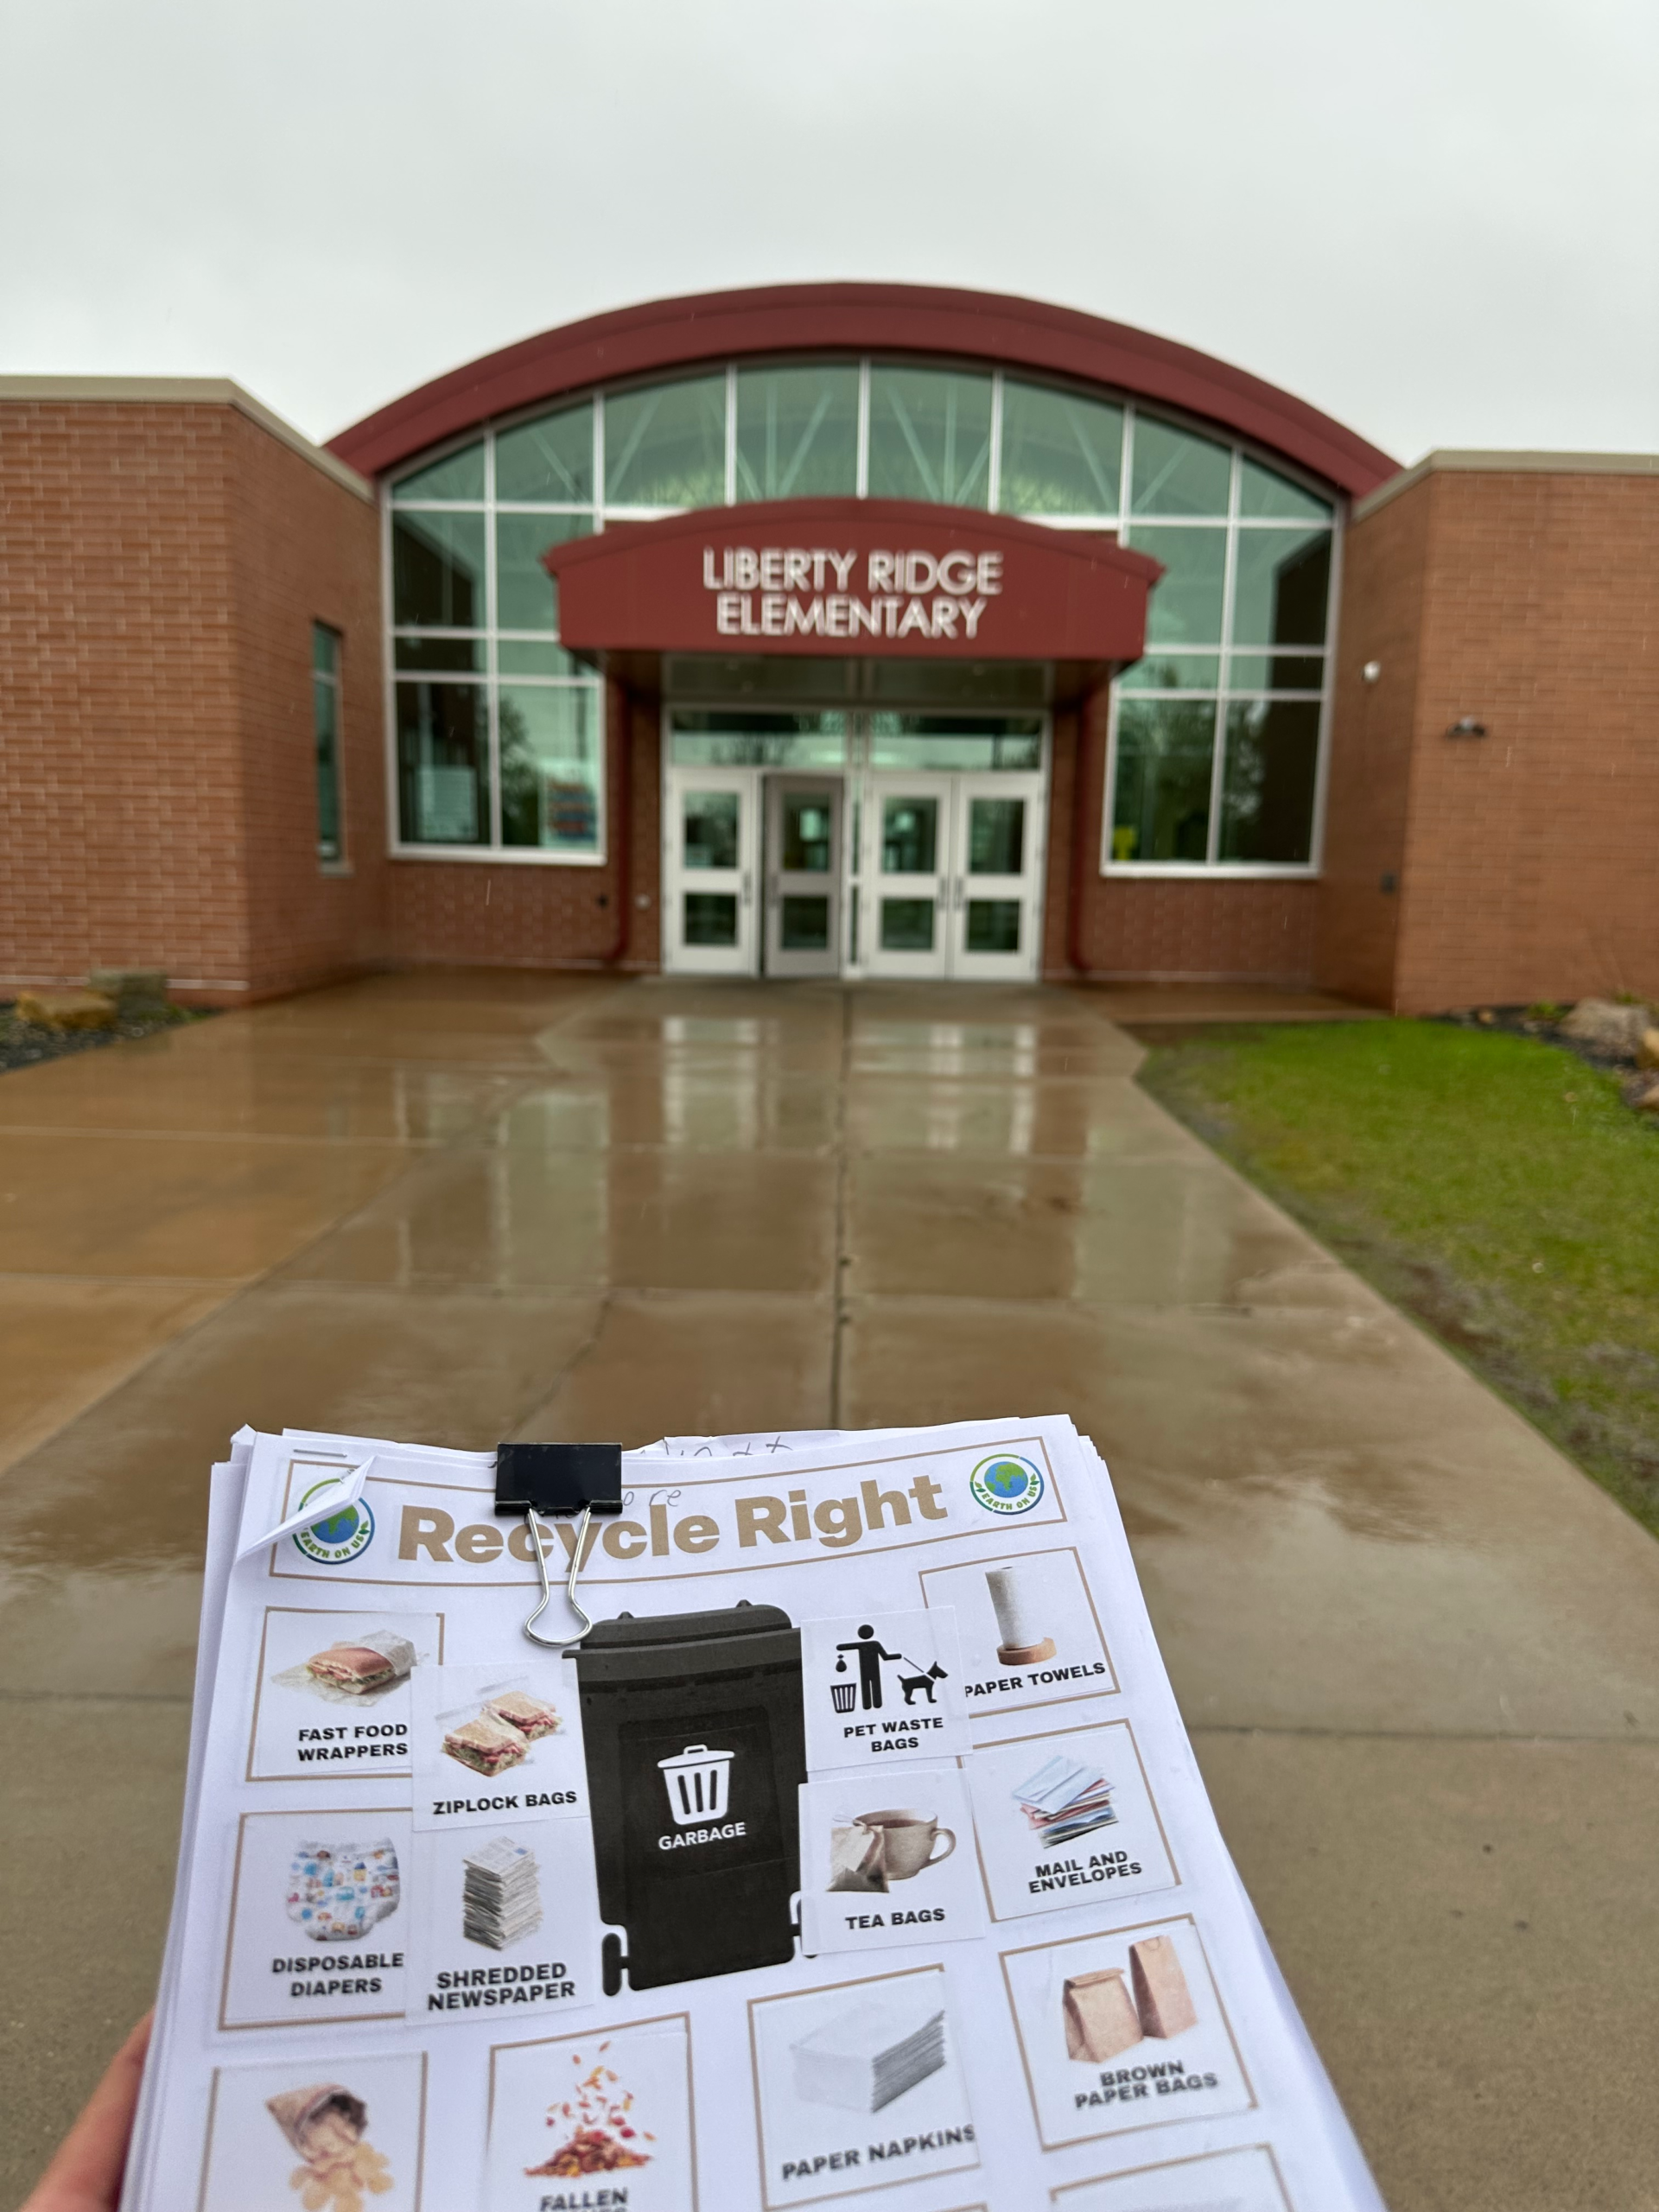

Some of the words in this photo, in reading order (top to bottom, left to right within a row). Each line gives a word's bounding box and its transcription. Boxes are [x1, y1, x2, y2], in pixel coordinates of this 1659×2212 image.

[702, 545, 857, 592] LIBERTY
[868, 549, 1003, 595] RIDGE
[716, 591, 987, 639] ELEMENTARY
[982, 1493, 1013, 1510] EARTH
[1016, 1497, 1030, 1509] ON
[1027, 1486, 1037, 1497] US
[398, 1504, 719, 1572] Recycle
[734, 1475, 948, 1548] Right
[301, 1532, 331, 1558] EARTH
[334, 1547, 351, 1559] ON
[351, 1535, 365, 1548] US
[965, 1677, 1023, 1697] PAPER
[1027, 1662, 1106, 1685] TOWELS
[298, 1727, 348, 1742] FAST
[353, 1724, 409, 1738] FOOD
[843, 1724, 876, 1738] PET
[881, 1717, 944, 1733] WASTE
[297, 1742, 409, 1762] WRAPPERS
[870, 1735, 918, 1753] BAGS
[432, 1795, 519, 1815] ZIPLOCK
[525, 1790, 577, 1808] BAGS
[658, 1821, 747, 1850] GARBAGE
[1028, 1861, 1142, 1893] ENVELOPES
[1035, 1859, 1084, 1878] MAIL
[1089, 1851, 1128, 1868] AND
[845, 1914, 884, 1930] TEA
[890, 1908, 945, 1926] BAGS
[272, 1952, 404, 1974] DISPOSABLE
[436, 1961, 568, 1988] SHREDDED
[290, 1977, 382, 1997] DIAPERS
[427, 1980, 575, 2011] NEWSPAPER
[1099, 2060, 1184, 2088] BROWN
[1075, 2081, 1150, 2109] PAPER
[1154, 2072, 1218, 2096] BAGS
[783, 2148, 861, 2179] PAPER
[868, 2123, 975, 2160] NAPKINS
[540, 2187, 628, 2211] FALLEN
